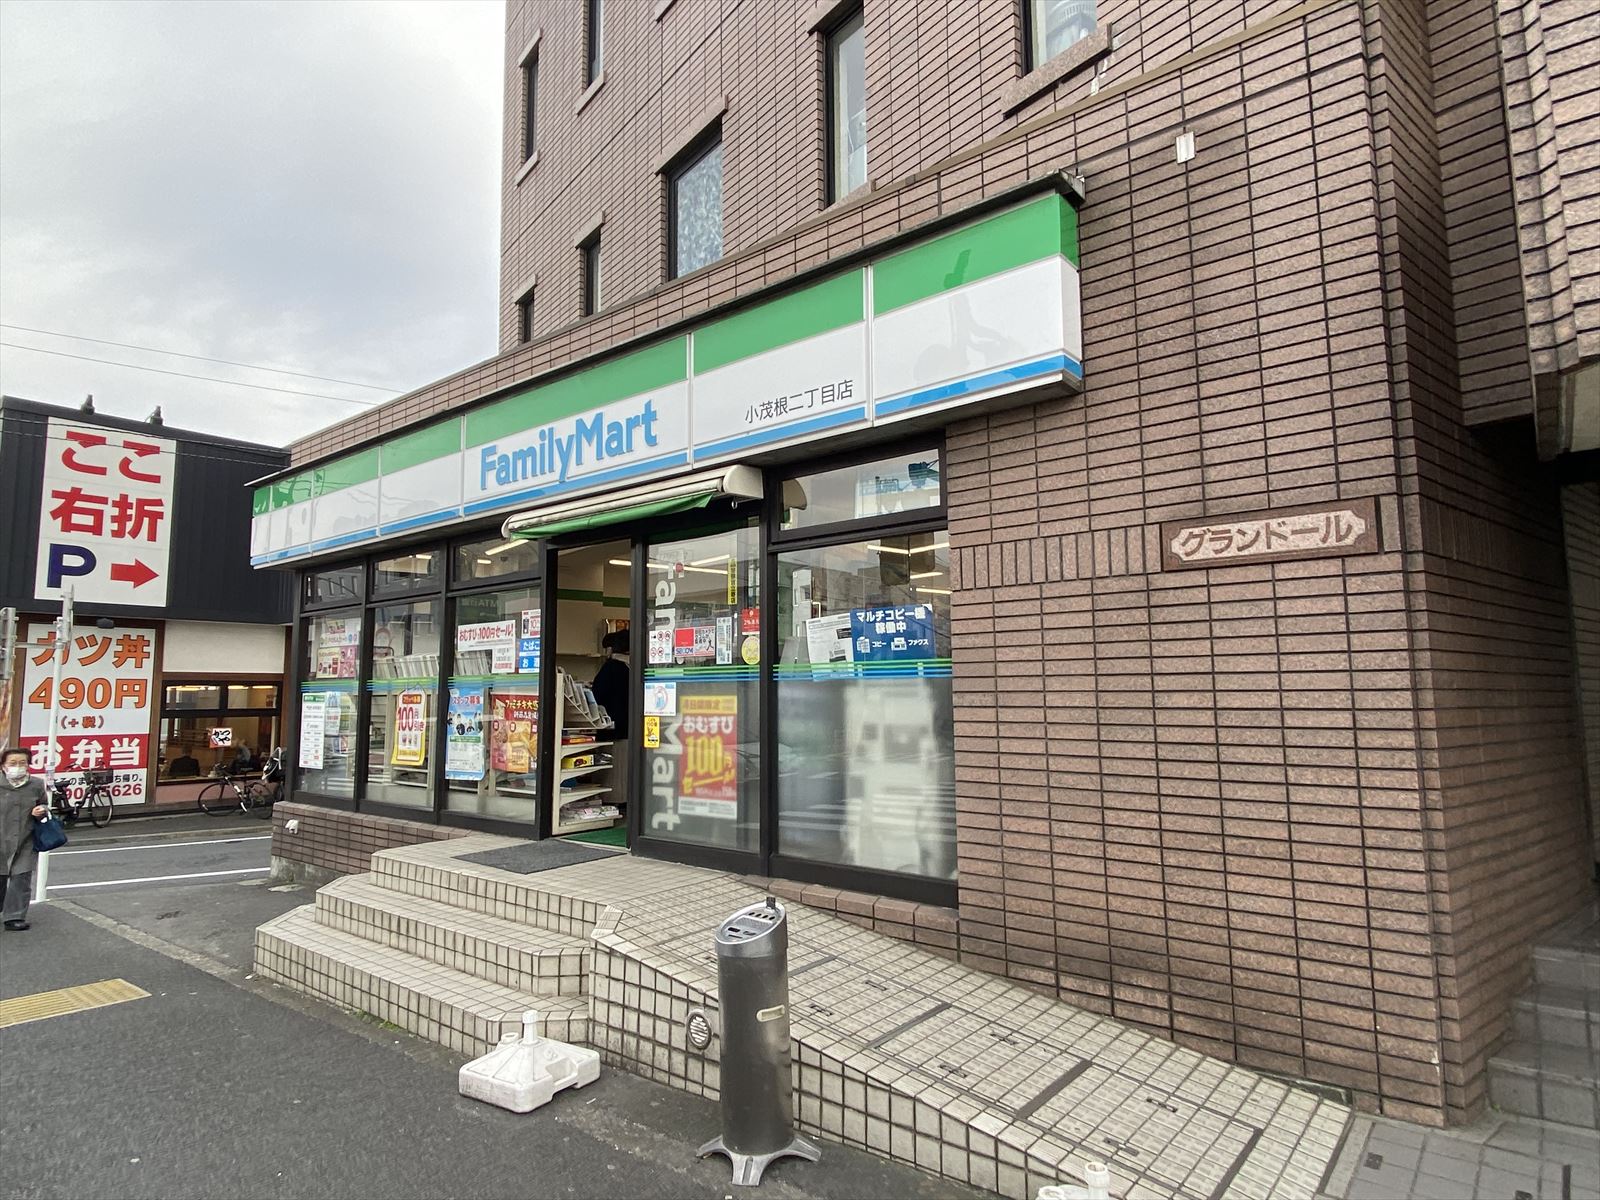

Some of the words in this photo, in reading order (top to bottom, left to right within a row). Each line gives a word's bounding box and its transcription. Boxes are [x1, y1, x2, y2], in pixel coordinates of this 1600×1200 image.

[744, 380, 854, 425] 小茂根二丁目店
[61, 430, 161, 484] ここ
[480, 399, 659, 492] FamilyMart
[49, 486, 165, 543] 右折
[1180, 514, 1354, 558] グランドール
[46, 543, 97, 589] P
[29, 737, 141, 770] お弁当
